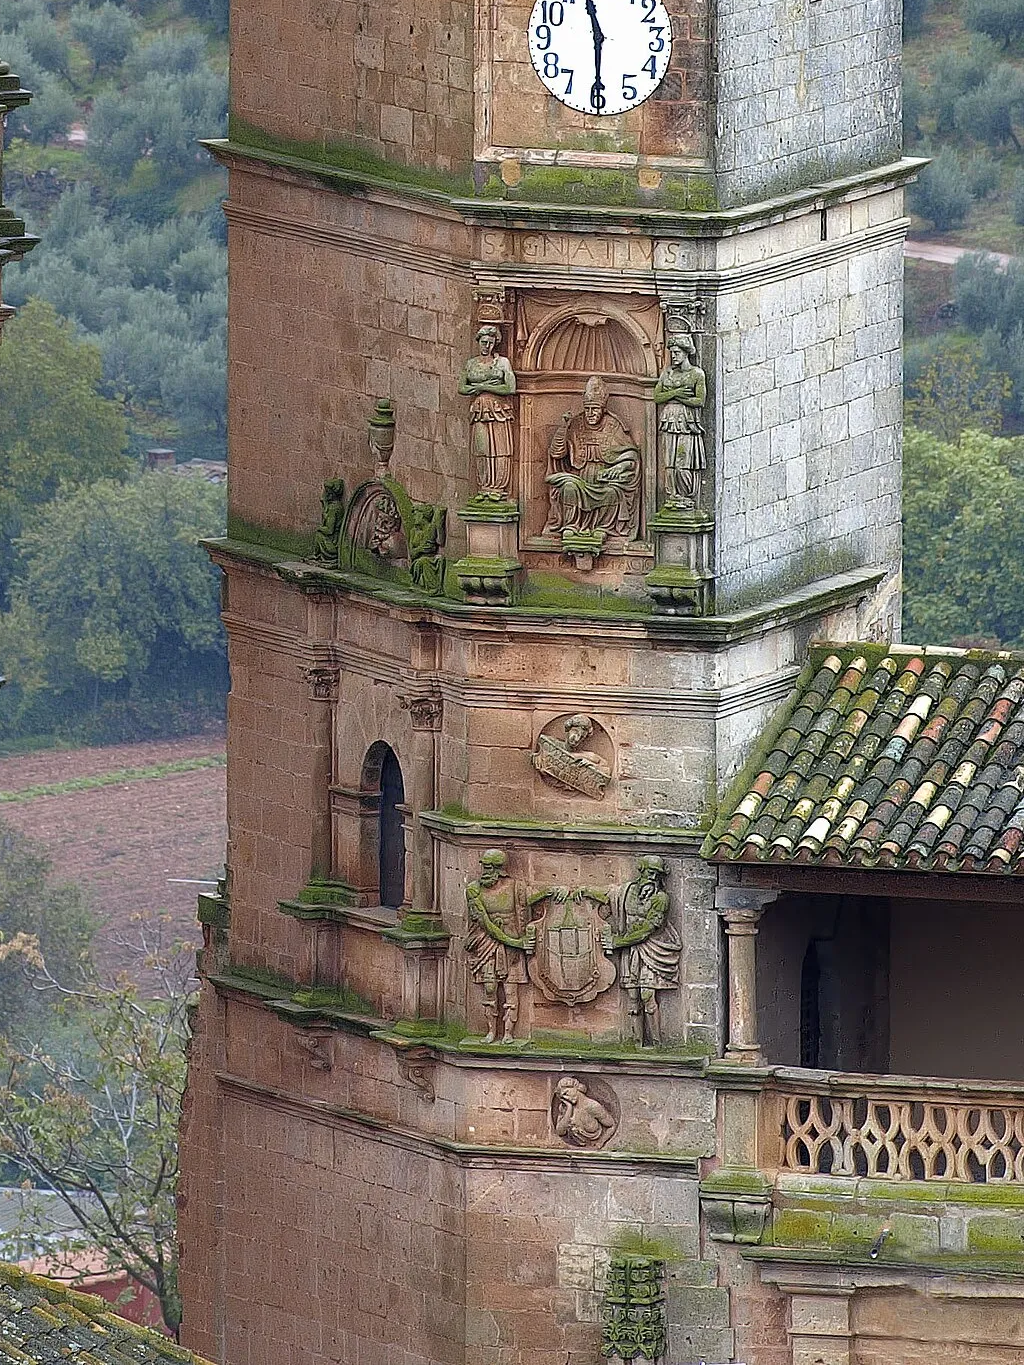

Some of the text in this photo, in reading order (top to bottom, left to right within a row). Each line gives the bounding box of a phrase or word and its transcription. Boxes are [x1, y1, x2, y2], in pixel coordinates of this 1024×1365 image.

[541, 0, 564, 26] 10
[535, 24, 552, 50] 9
[648, 26, 665, 52] 3
[543, 52, 559, 78] 8
[641, 55, 657, 80] 4
[560, 68, 574, 94] 7
[621, 73, 637, 100] 5
[590, 83, 606, 109] 6
